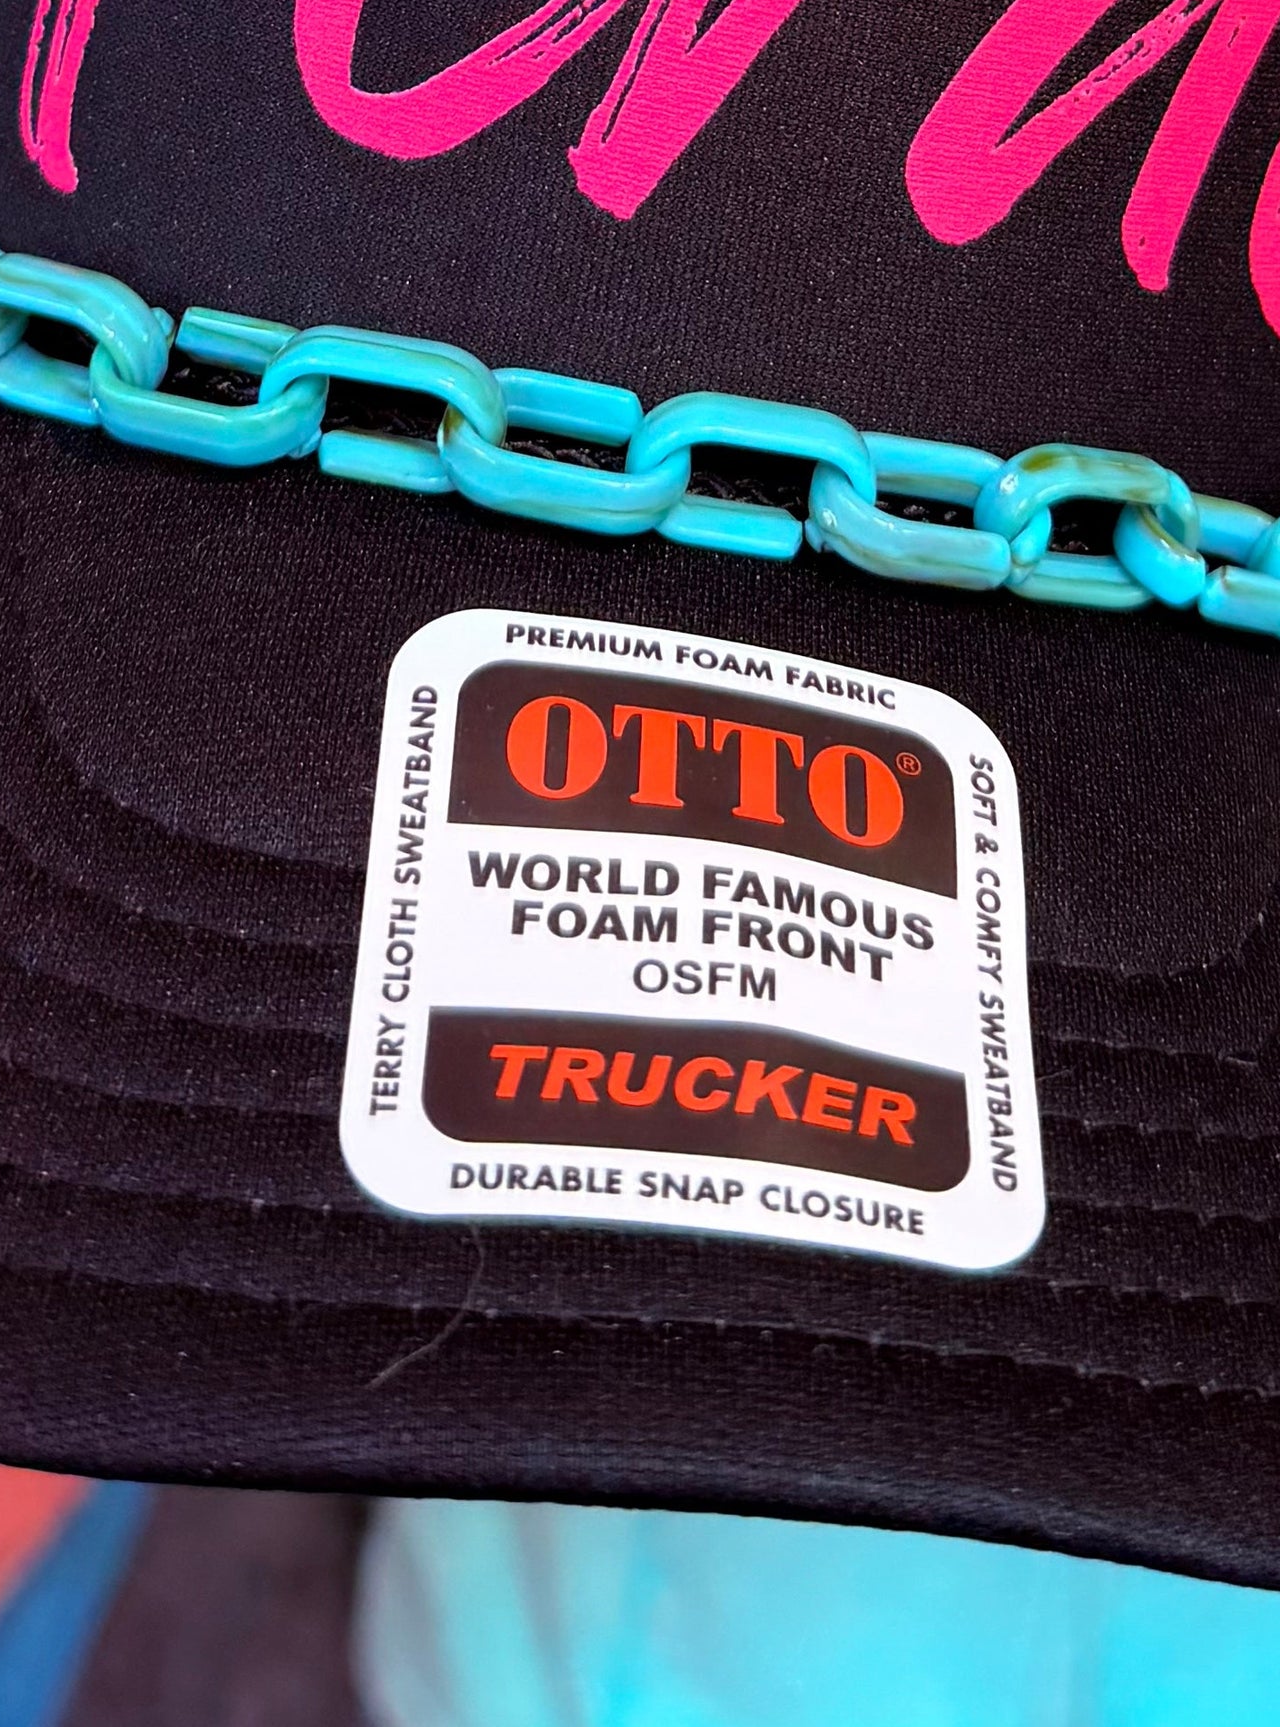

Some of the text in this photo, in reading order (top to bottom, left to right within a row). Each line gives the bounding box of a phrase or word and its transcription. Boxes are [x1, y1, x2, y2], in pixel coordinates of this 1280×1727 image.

[506, 624, 896, 710] PREMIUM FOAM FABRIC
[370, 684, 438, 1116] TERRY CLOTH SWEATBAND
[468, 851, 934, 951] WORLD FAMOUS
[511, 900, 892, 982] FOAM FRONT
[632, 958, 777, 1001] OSFM
[970, 753, 1018, 1192] SOFT & COMFY SWEATBAND
[489, 1044, 917, 1145] TRUCKER
[450, 1164, 925, 1236] DURABLE SNAP CLOSURE
